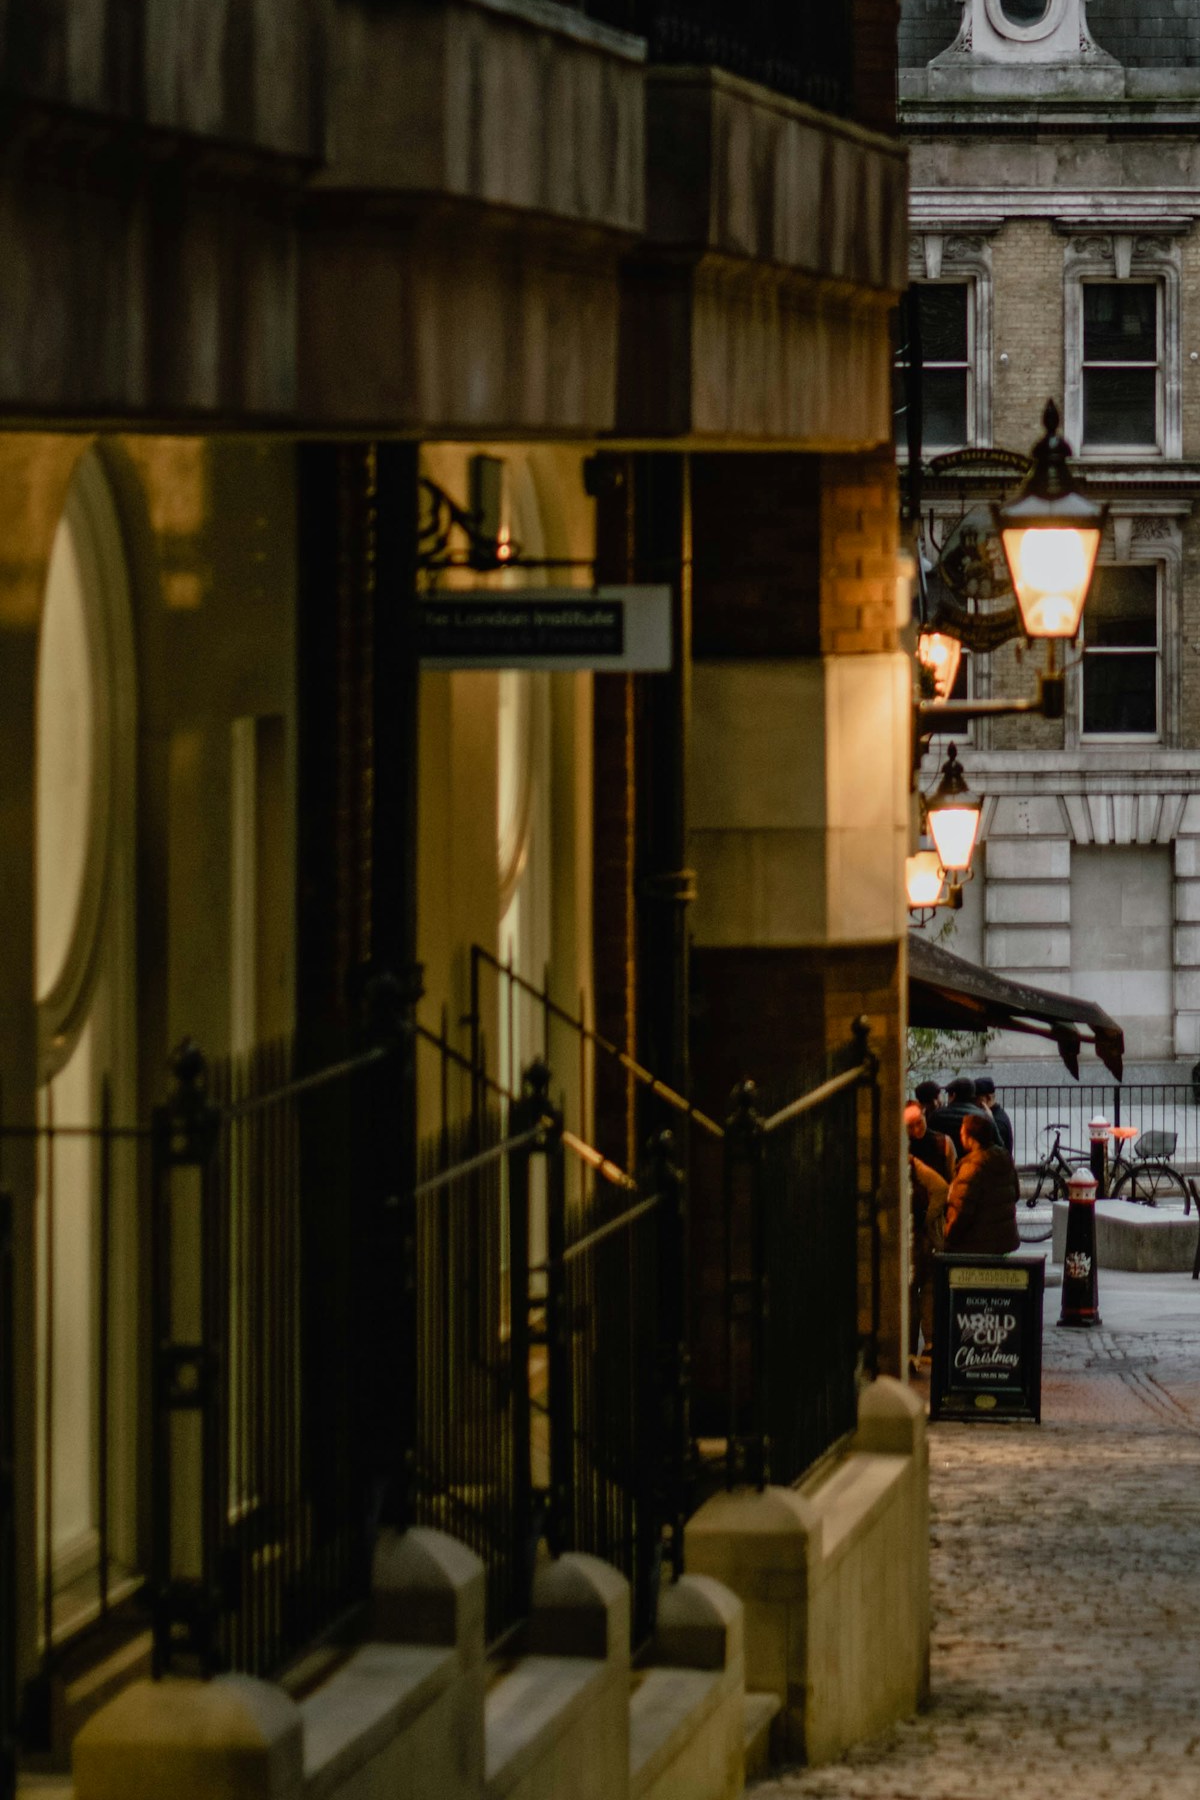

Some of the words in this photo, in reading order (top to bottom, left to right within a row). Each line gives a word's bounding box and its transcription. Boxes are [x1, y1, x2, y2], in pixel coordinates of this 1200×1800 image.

[966, 1297, 987, 1306] BOOK
[991, 1297, 1011, 1307] NOW
[957, 1314, 1016, 1330] WORLD
[973, 1328, 1008, 1344] CUP
[954, 1345, 1019, 1368] Christmas
